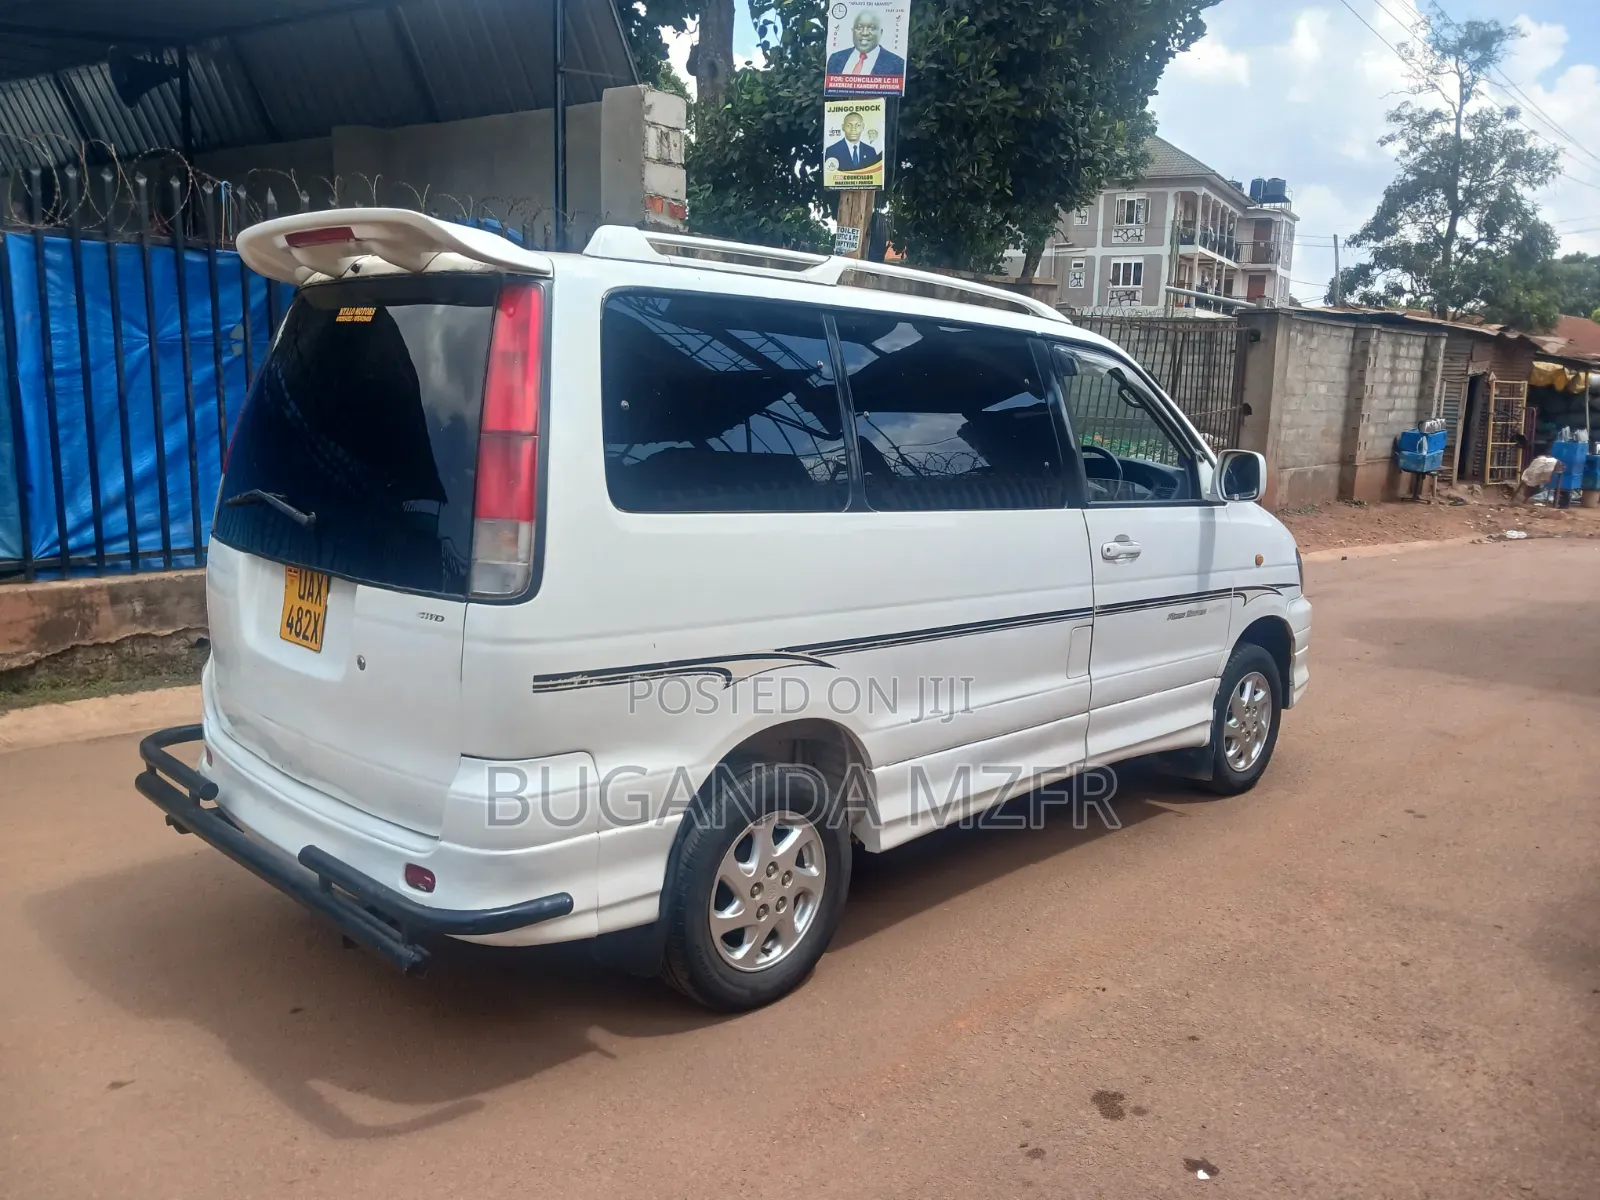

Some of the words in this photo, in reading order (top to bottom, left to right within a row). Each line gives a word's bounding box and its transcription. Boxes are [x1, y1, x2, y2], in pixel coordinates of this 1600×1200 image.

[855, 104, 881, 112] ENOCK
[837, 226, 860, 235] TOILET
[298, 569, 322, 607] UAX
[286, 604, 321, 645] 482X
